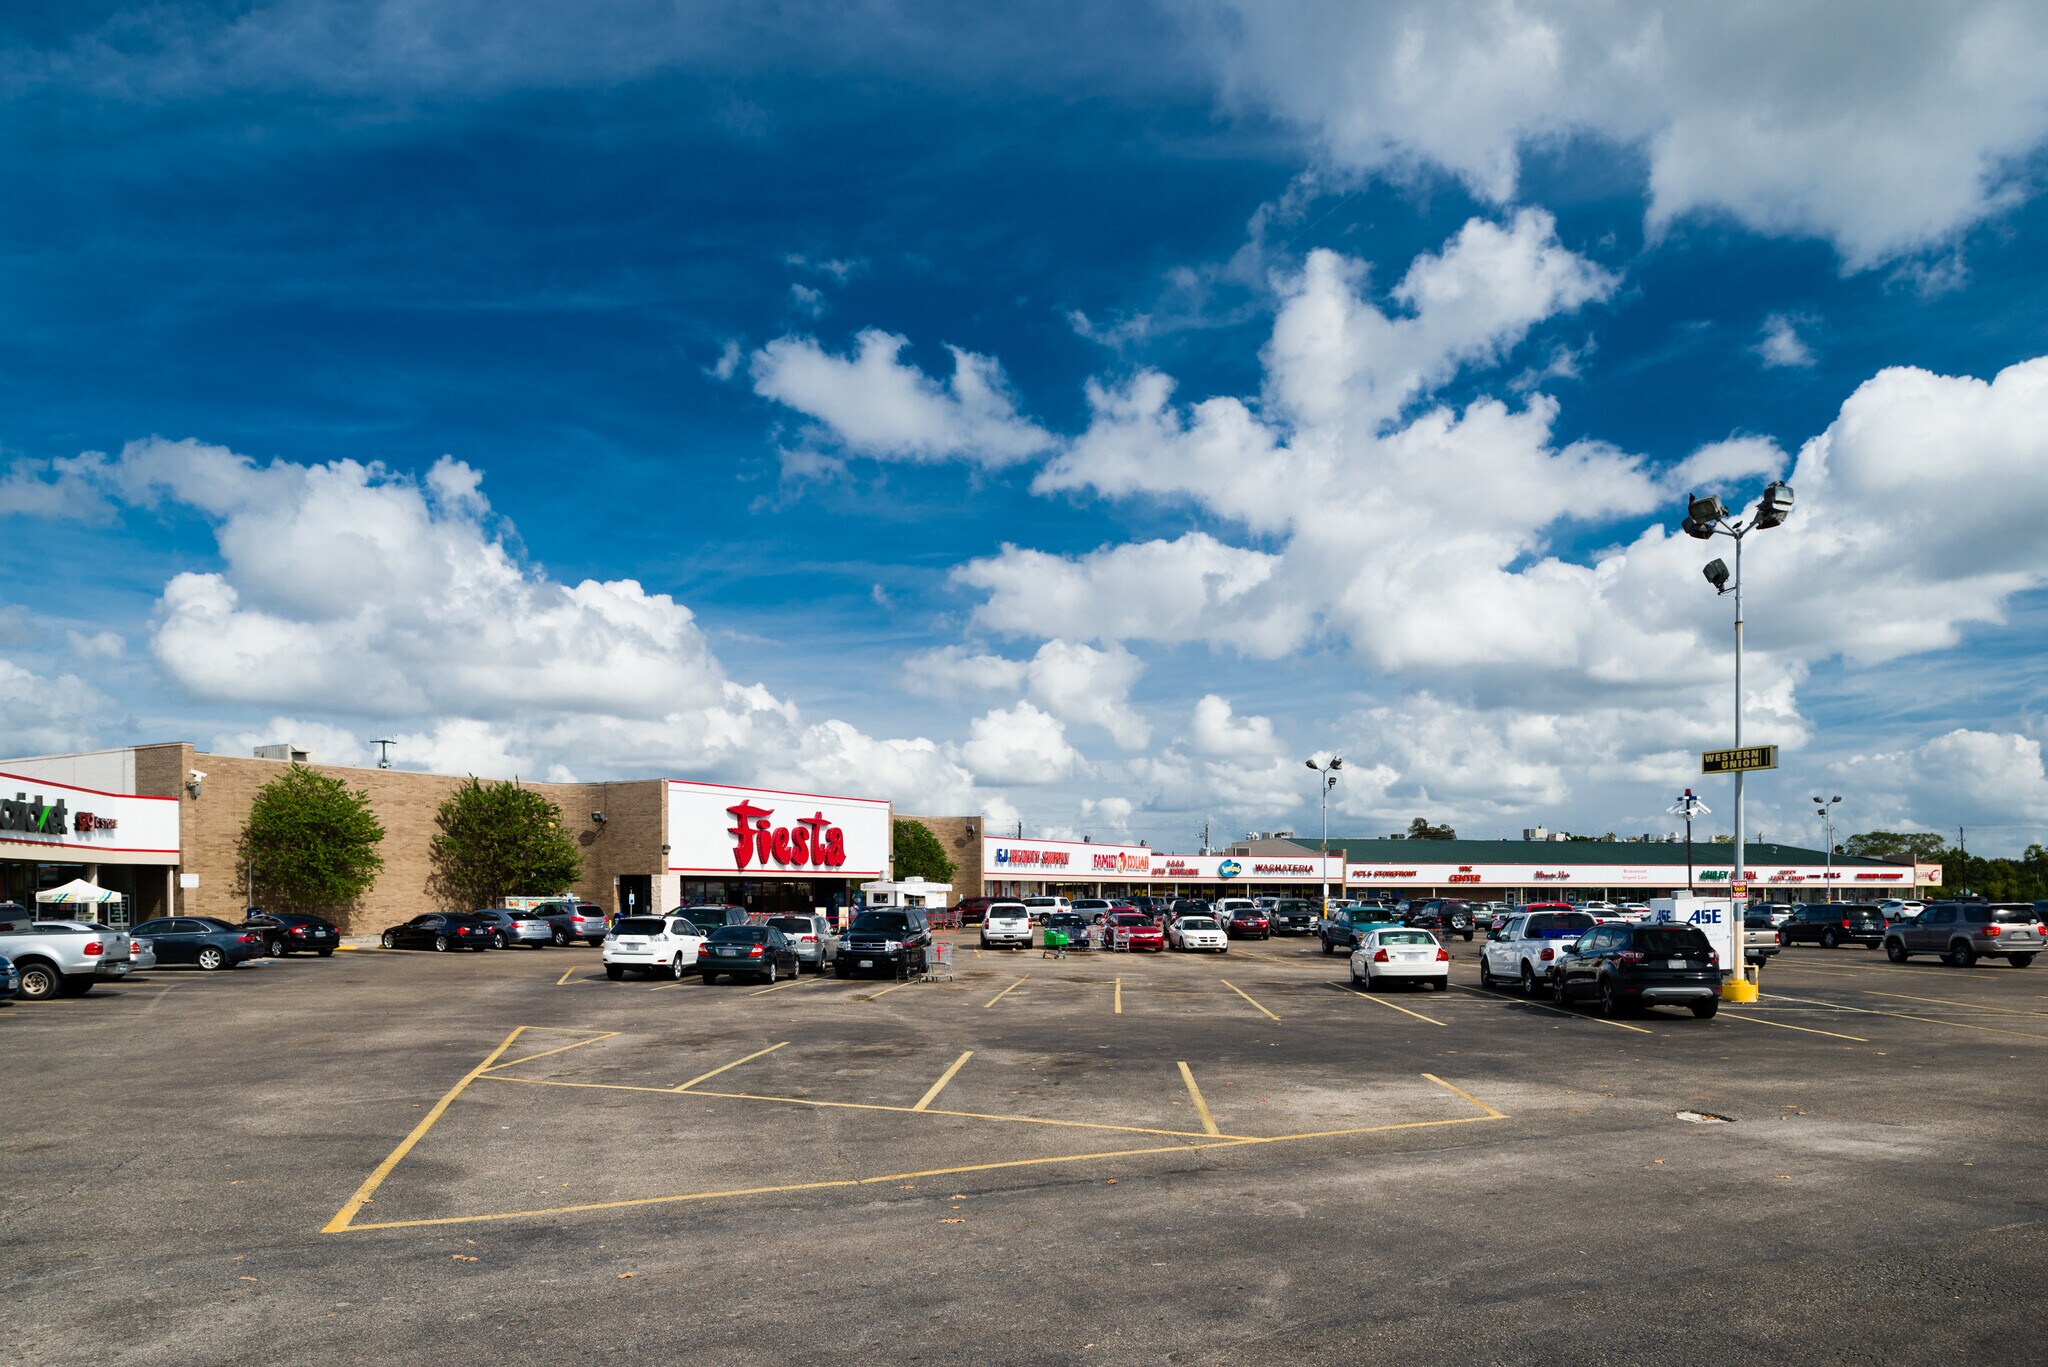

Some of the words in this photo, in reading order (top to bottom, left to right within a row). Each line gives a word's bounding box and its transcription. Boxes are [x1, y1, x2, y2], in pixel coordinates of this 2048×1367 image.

[1705, 749, 1759, 762] WESTERN
[1721, 758, 1759, 769] UNION
[726, 799, 847, 870] Fiesta
[997, 848, 1008, 863] EJ
[1010, 849, 1041, 864] BEAUTY
[1042, 850, 1070, 865] SUPPLY
[1093, 854, 1117, 869] FAMILY
[1127, 855, 1149, 870] DOLLAR
[1255, 864, 1314, 873] WASHATERIA
[1700, 870, 1728, 880] ASHLEY
[1730, 870, 1758, 880] DTAL
[1449, 874, 1481, 882] CENTER
[1656, 909, 1671, 922] ASE
[1687, 909, 1722, 924] ASE
